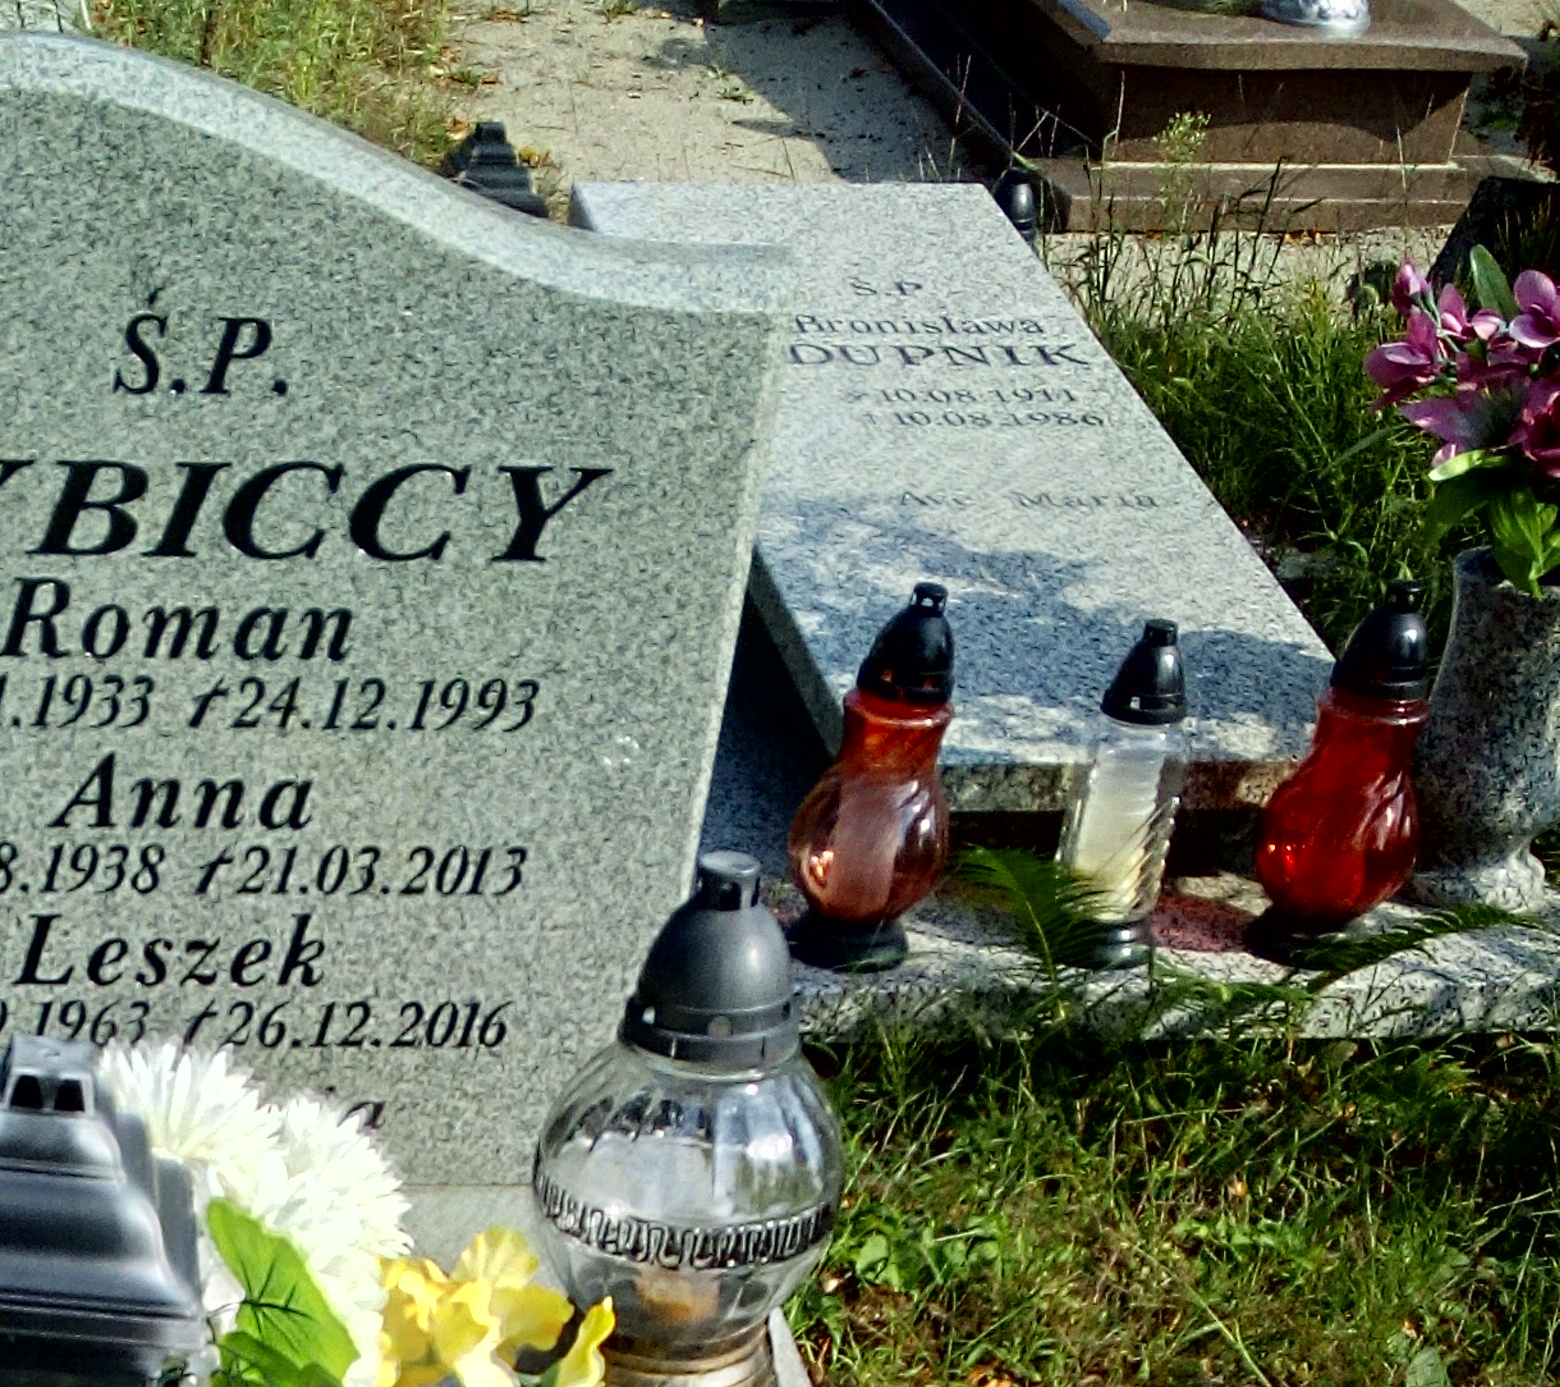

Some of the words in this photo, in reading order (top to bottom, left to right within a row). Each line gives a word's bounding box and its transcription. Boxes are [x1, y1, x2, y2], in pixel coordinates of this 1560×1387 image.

[113, 287, 288, 395] Ś.P.
[789, 343, 1090, 366] DUPNIK
[48, 753, 314, 830] Anna
[14, 913, 327, 988] Leszek
